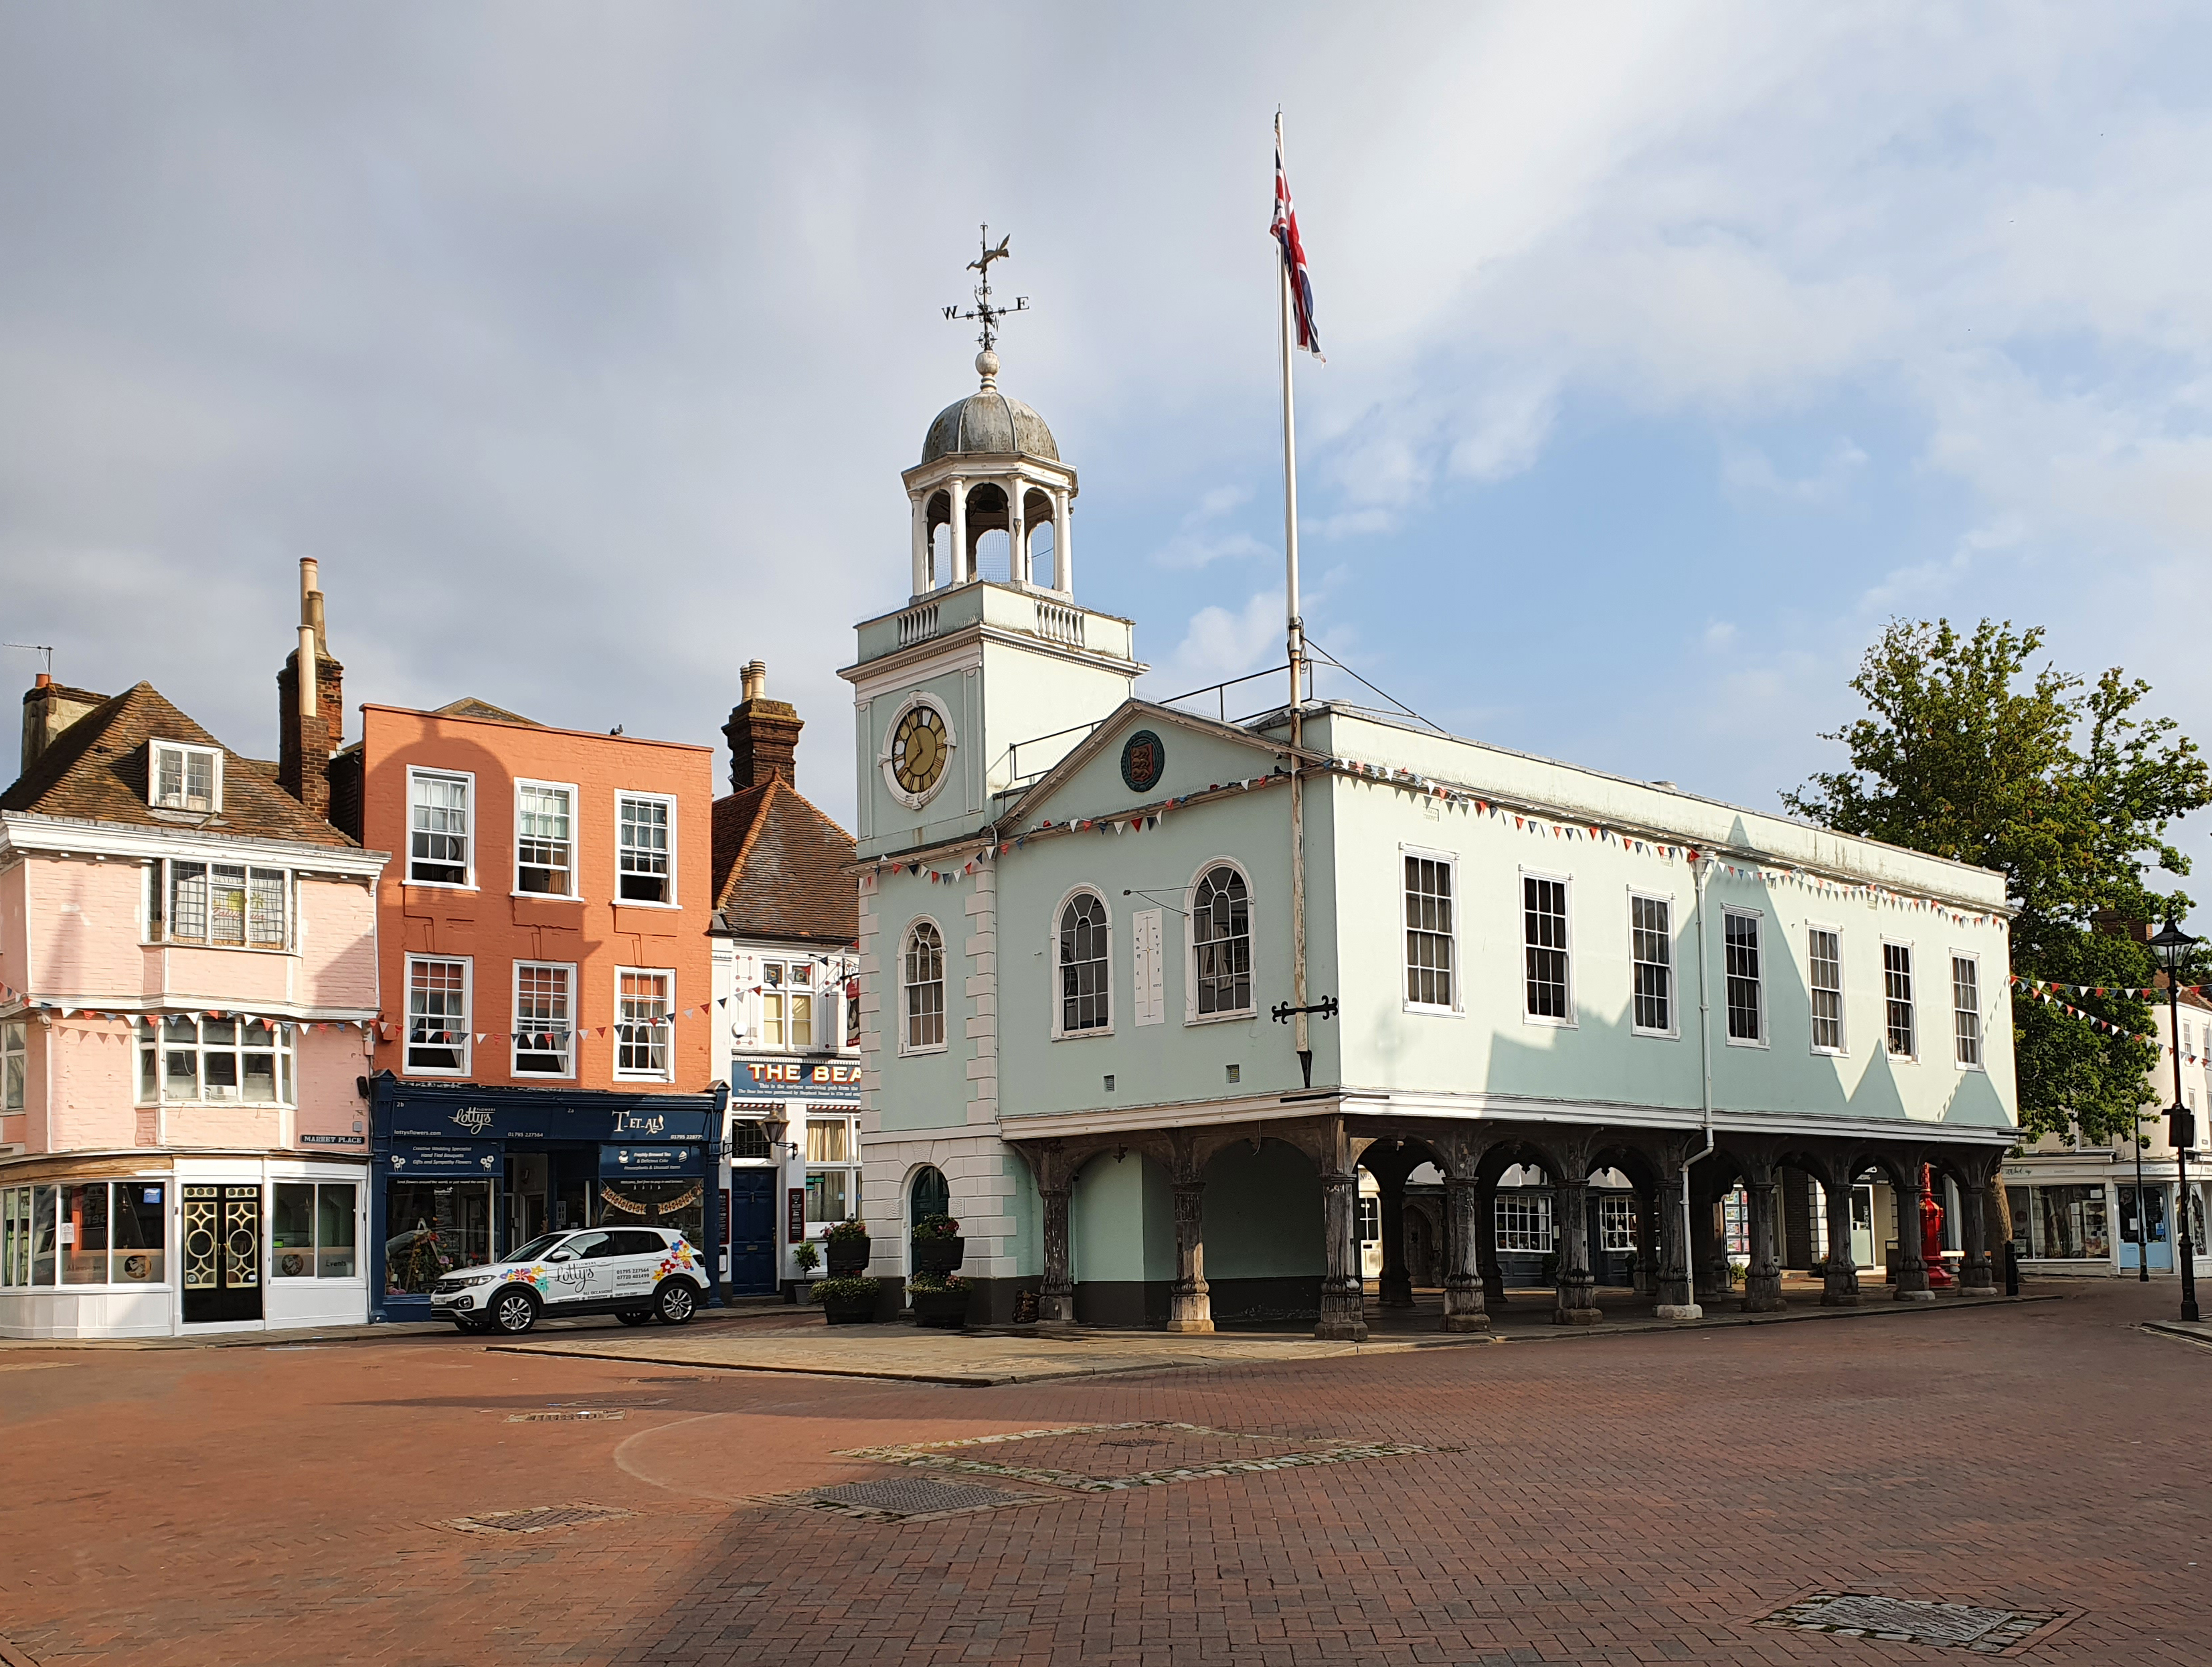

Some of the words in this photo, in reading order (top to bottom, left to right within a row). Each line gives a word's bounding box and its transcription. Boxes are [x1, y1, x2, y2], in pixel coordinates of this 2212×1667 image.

[941, 305, 958, 320] W
[1015, 297, 1029, 310] E
[747, 1063, 801, 1083] THE
[448, 1107, 494, 1135] Lotty's
[548, 1263, 598, 1293] Lotty's
